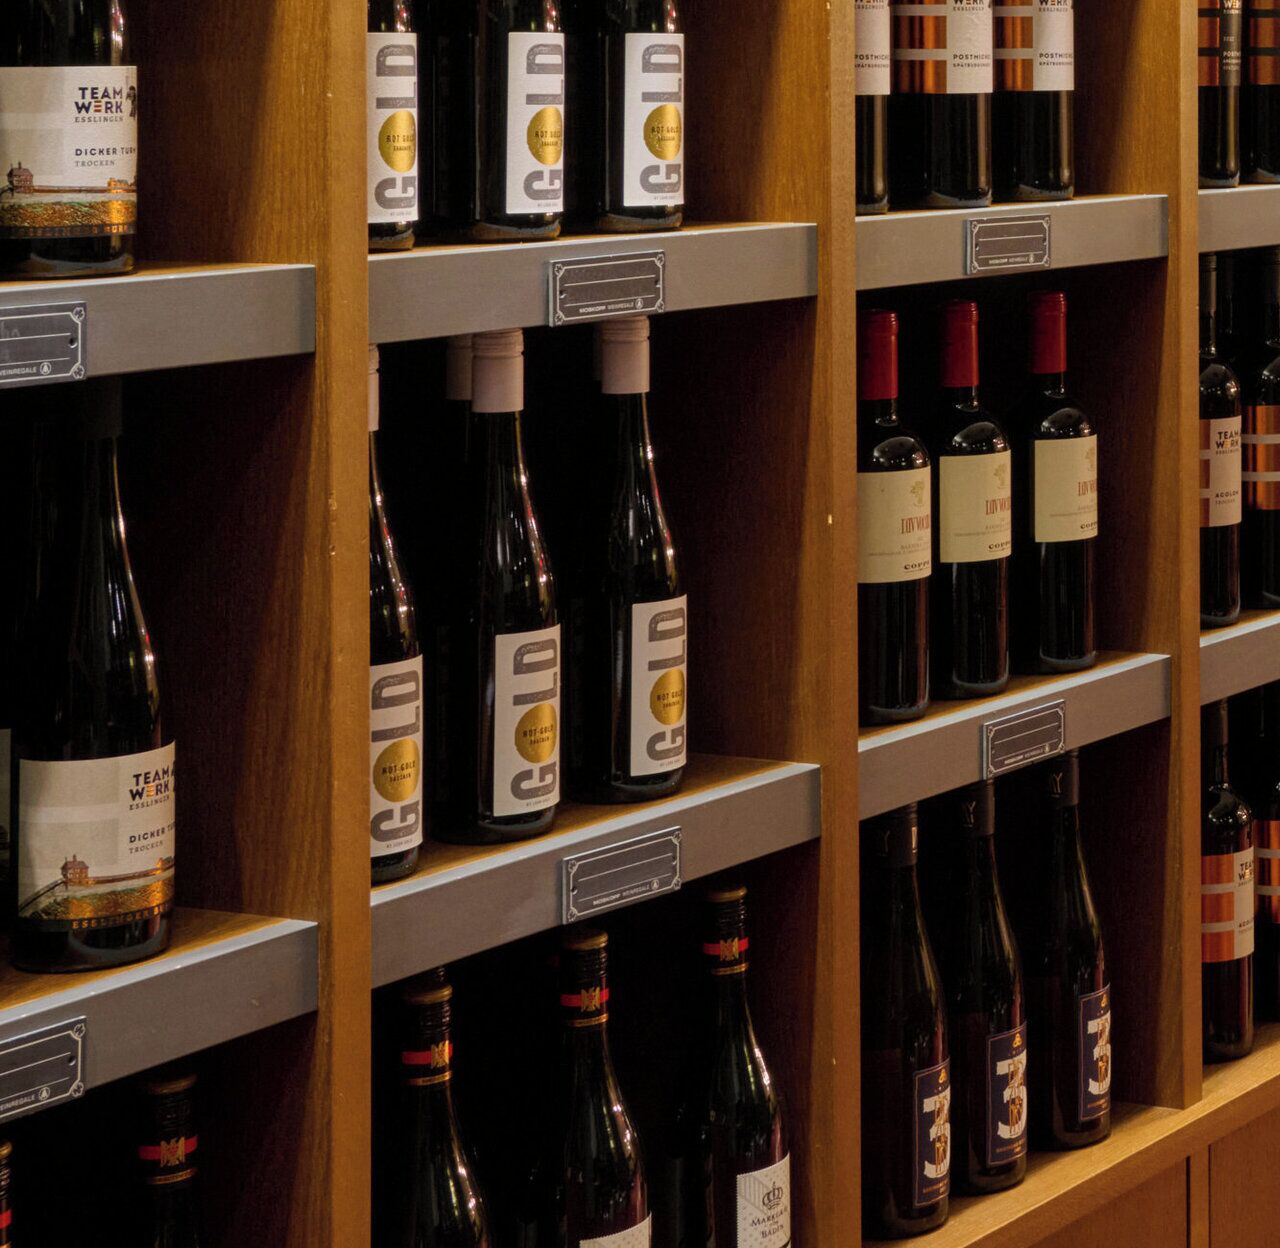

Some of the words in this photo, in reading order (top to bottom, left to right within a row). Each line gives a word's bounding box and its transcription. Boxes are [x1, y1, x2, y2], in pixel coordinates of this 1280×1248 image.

[78, 86, 123, 101] TEAM
[75, 101, 123, 114] WERK
[75, 147, 118, 157] DICKER
[1218, 431, 1239, 439] TEAM
[133, 765, 169, 786] TEAM
[129, 779, 169, 801] WERK
[129, 795, 170, 811] ESSLINGEN
[129, 827, 166, 844] DICKER
[129, 840, 163, 854] TROCKEN
[1087, 1010, 1111, 1095] 3
[996, 1049, 1027, 1139] 3
